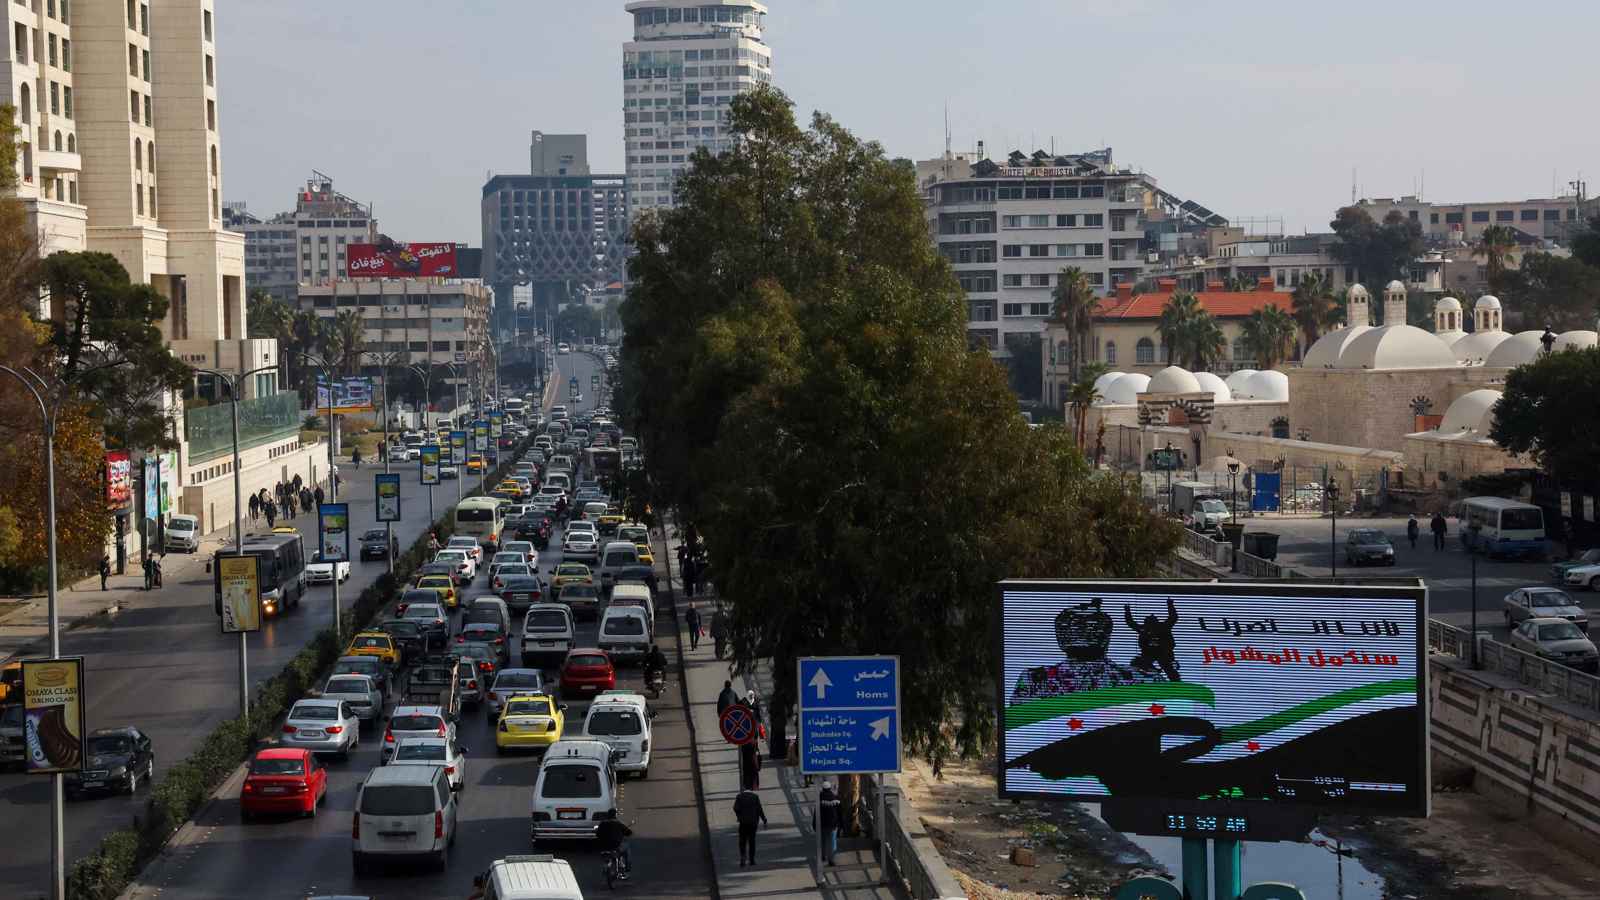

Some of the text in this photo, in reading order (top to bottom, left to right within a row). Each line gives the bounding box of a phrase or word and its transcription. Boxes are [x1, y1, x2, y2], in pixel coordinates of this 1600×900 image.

[1001, 167, 1028, 177] HOTEL
[1202, 645, 1399, 667] سنكمل المشوار
[854, 669, 890, 682] حمص
[856, 691, 889, 699] Homs
[839, 716, 856, 725] ساحة
[808, 742, 856, 754] ساحة الحجاز
[1168, 815, 1186, 828] 11
[1226, 818, 1246, 832] AM
